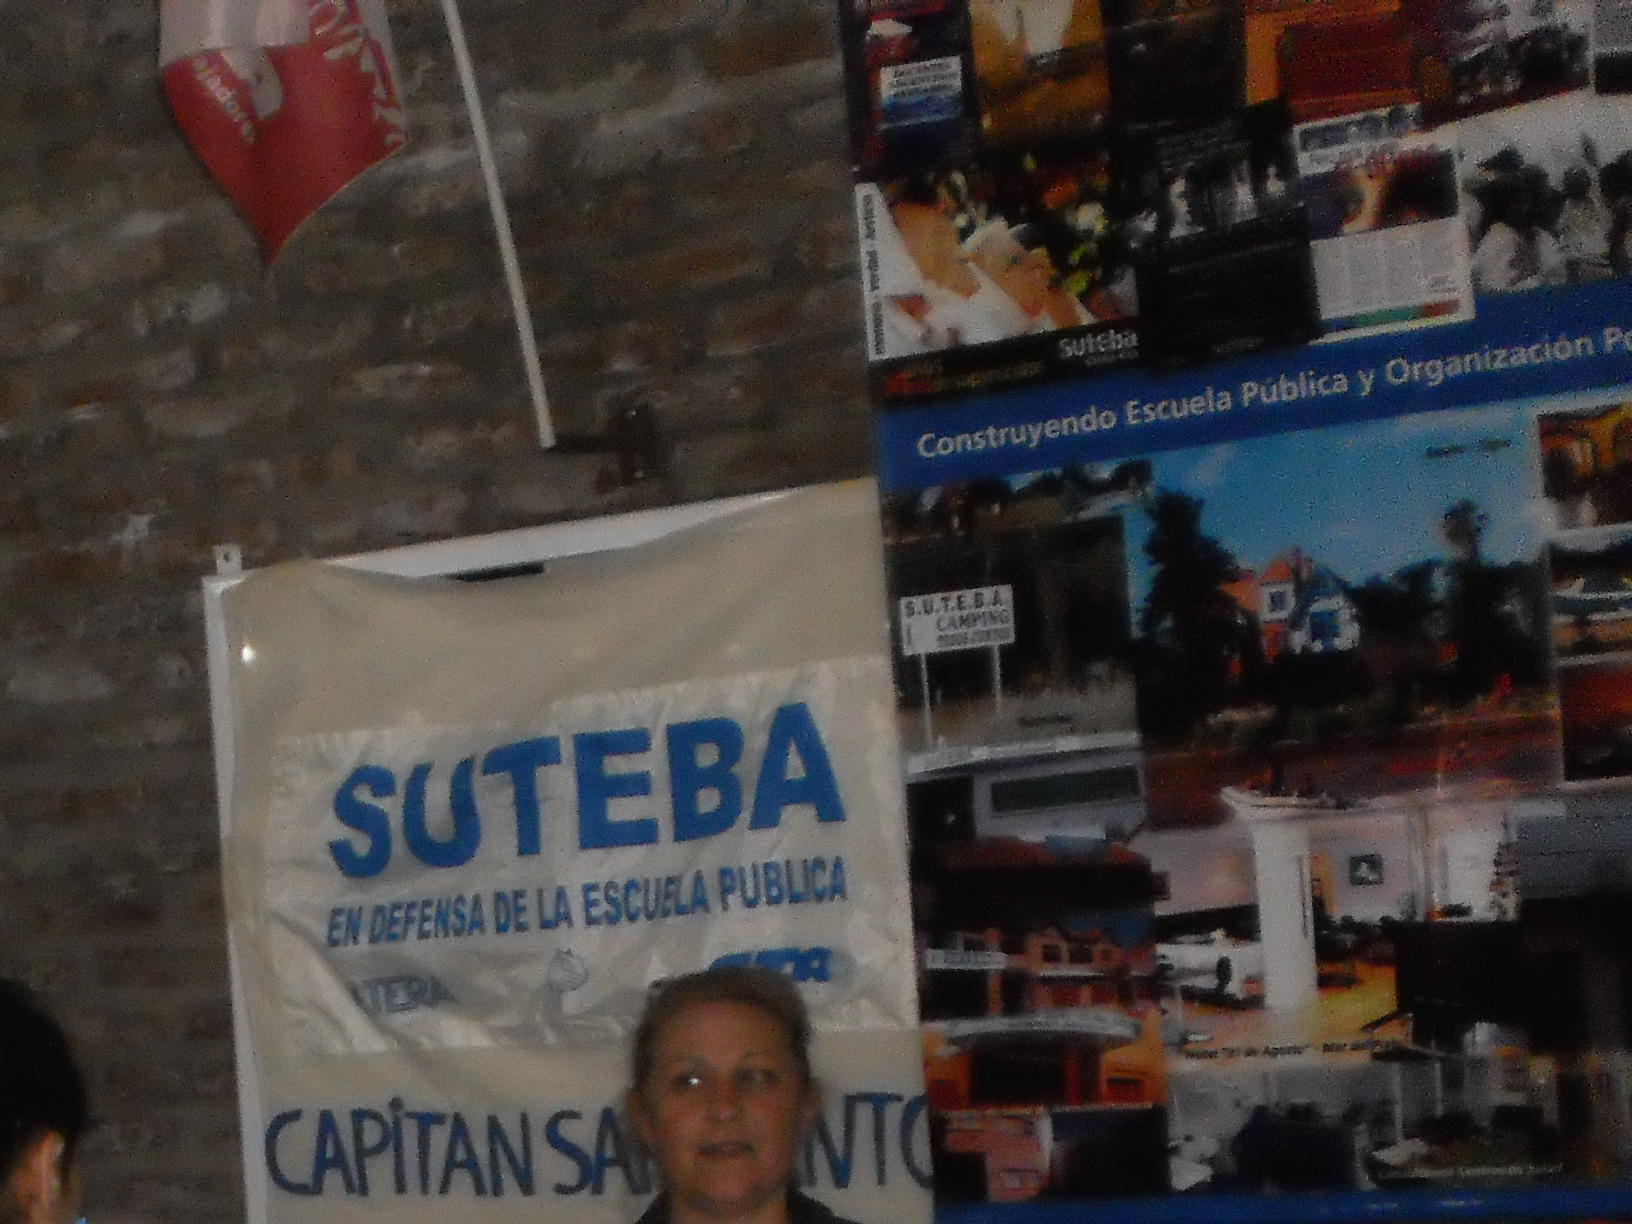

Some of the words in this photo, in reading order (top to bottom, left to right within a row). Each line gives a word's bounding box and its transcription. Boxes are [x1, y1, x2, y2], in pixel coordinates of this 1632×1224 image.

[917, 402, 1117, 460] Construyendo
[1125, 383, 1231, 427] Escuela
[1240, 364, 1349, 411] Pública
[1357, 367, 1376, 397] y
[1383, 332, 1595, 390] Organización
[327, 701, 847, 879] SUTEBA
[326, 904, 362, 949] EN
[368, 892, 486, 942] DEFENSA
[493, 888, 529, 934] DE
[535, 884, 571, 930] LA
[583, 870, 709, 926] ESCUELA
[719, 856, 848, 908] PUBLICA
